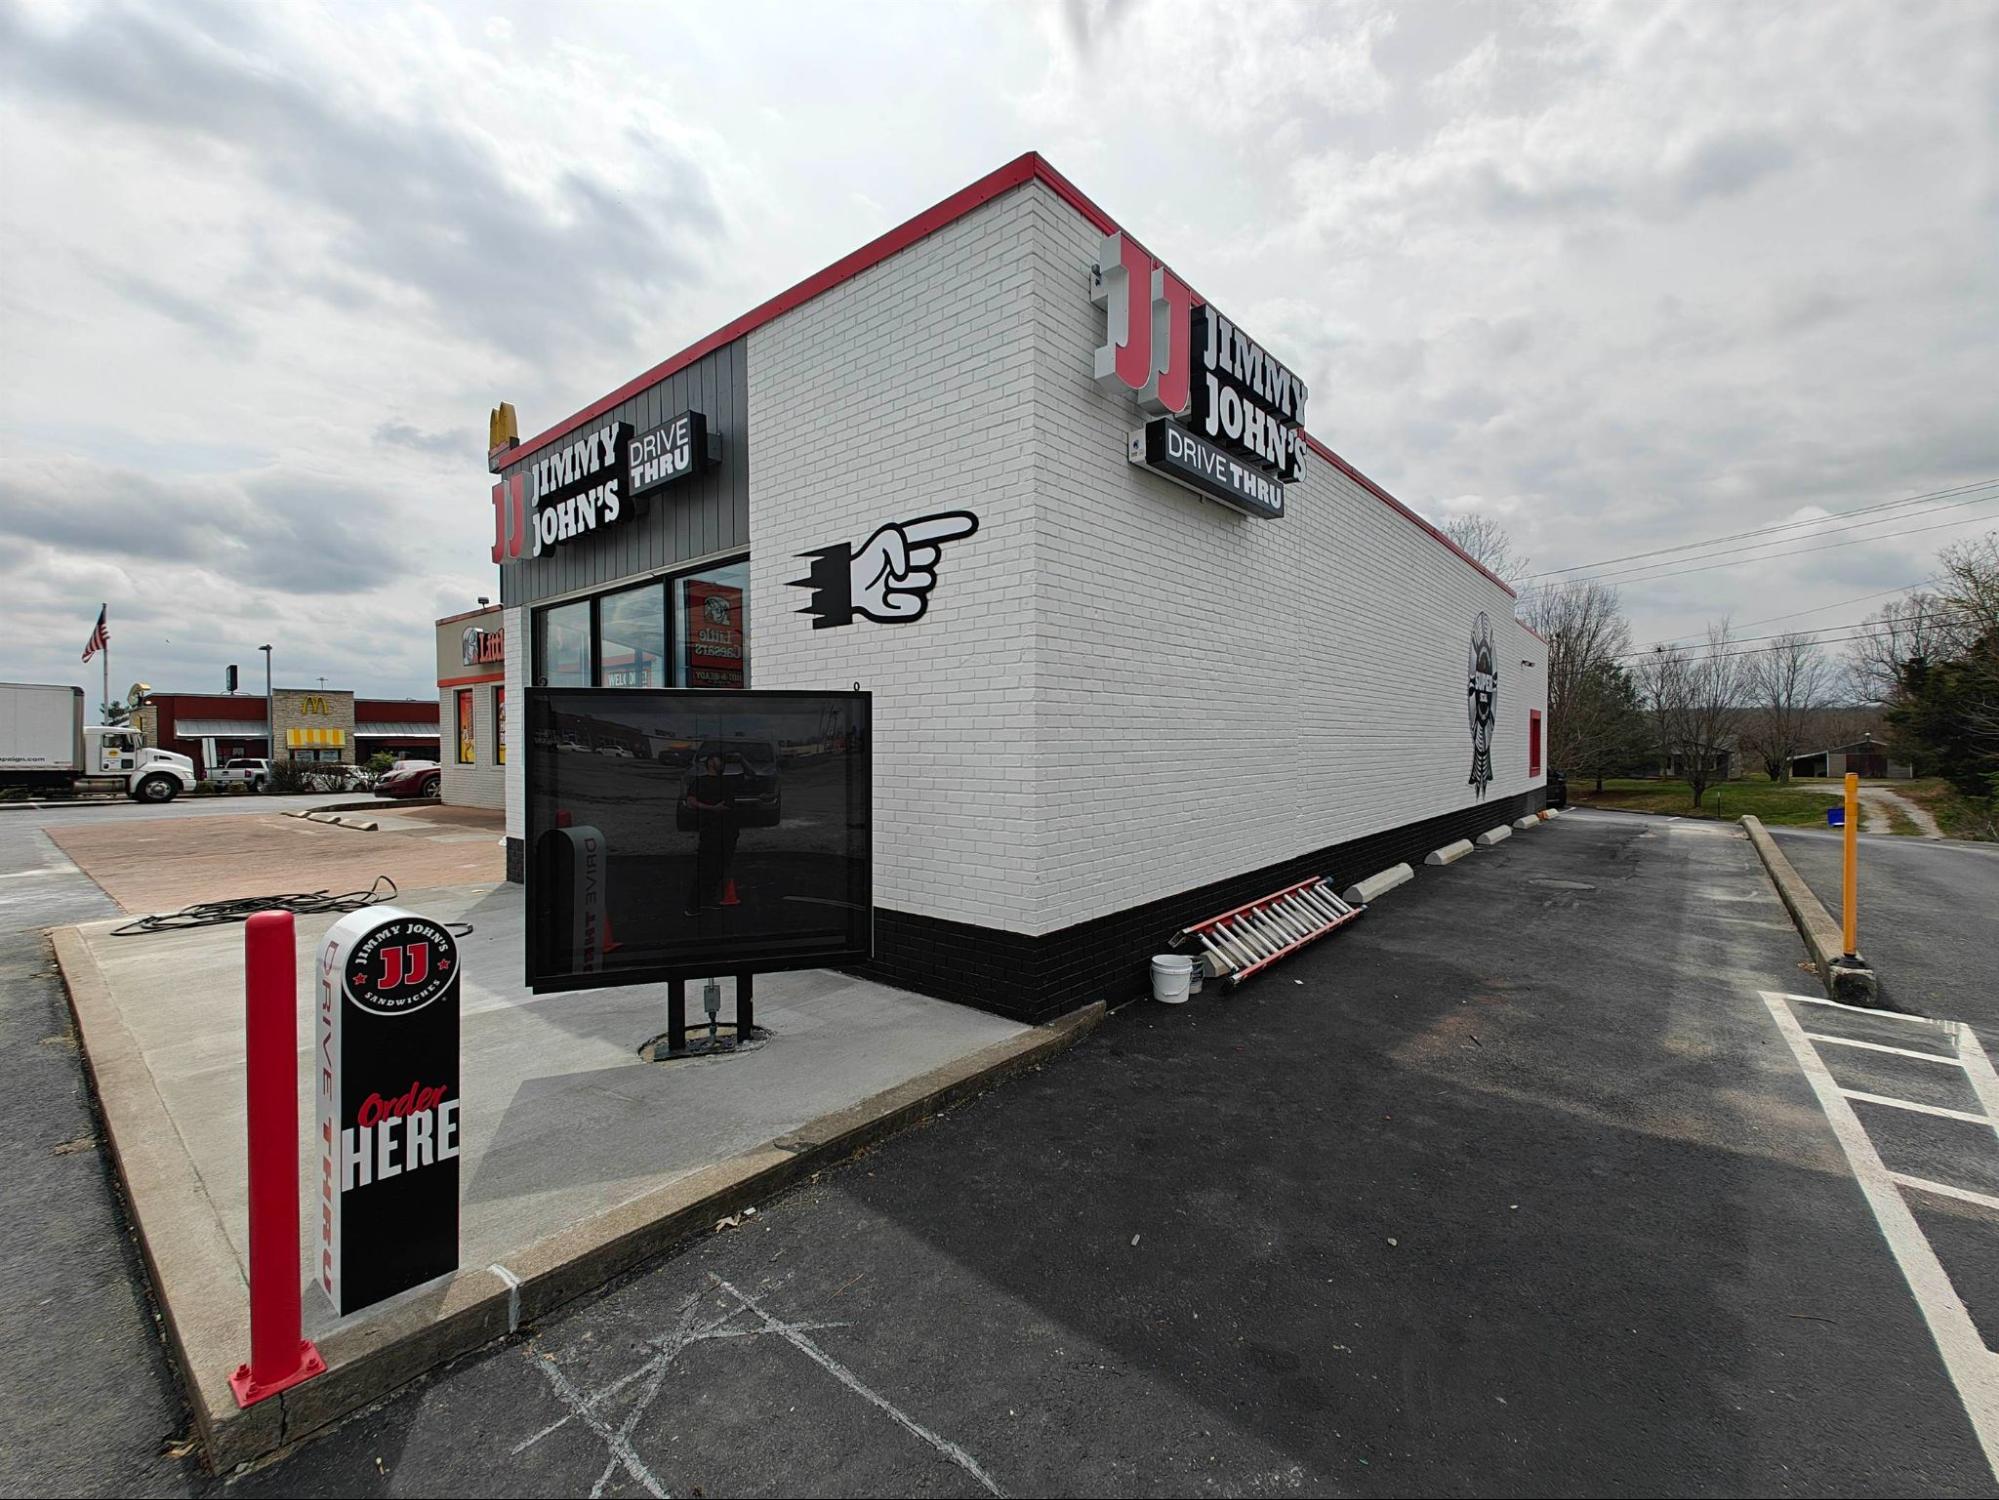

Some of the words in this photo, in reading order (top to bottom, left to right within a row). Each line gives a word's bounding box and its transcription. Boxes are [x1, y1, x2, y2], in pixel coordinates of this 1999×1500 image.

[1204, 309, 1308, 423] JIMMY
[532, 422, 619, 507] JIMMY
[630, 418, 688, 467] DRIVE
[631, 444, 689, 488] THRU
[1206, 375, 1307, 482] JOHN'S
[1168, 429, 1226, 480] DRIVE
[1230, 464, 1282, 508] THRU
[532, 479, 619, 557] JOHN'S
[355, 925, 400, 965] JIMMY
[406, 924, 448, 952] JOHN'S
[378, 942, 428, 989] JJ
[322, 940, 338, 1100] DRIVE
[365, 980, 440, 1006] SANDWICHES
[358, 1081, 447, 1128] Order
[342, 1098, 459, 1192] HERE
[321, 1121, 332, 1295] THRU
